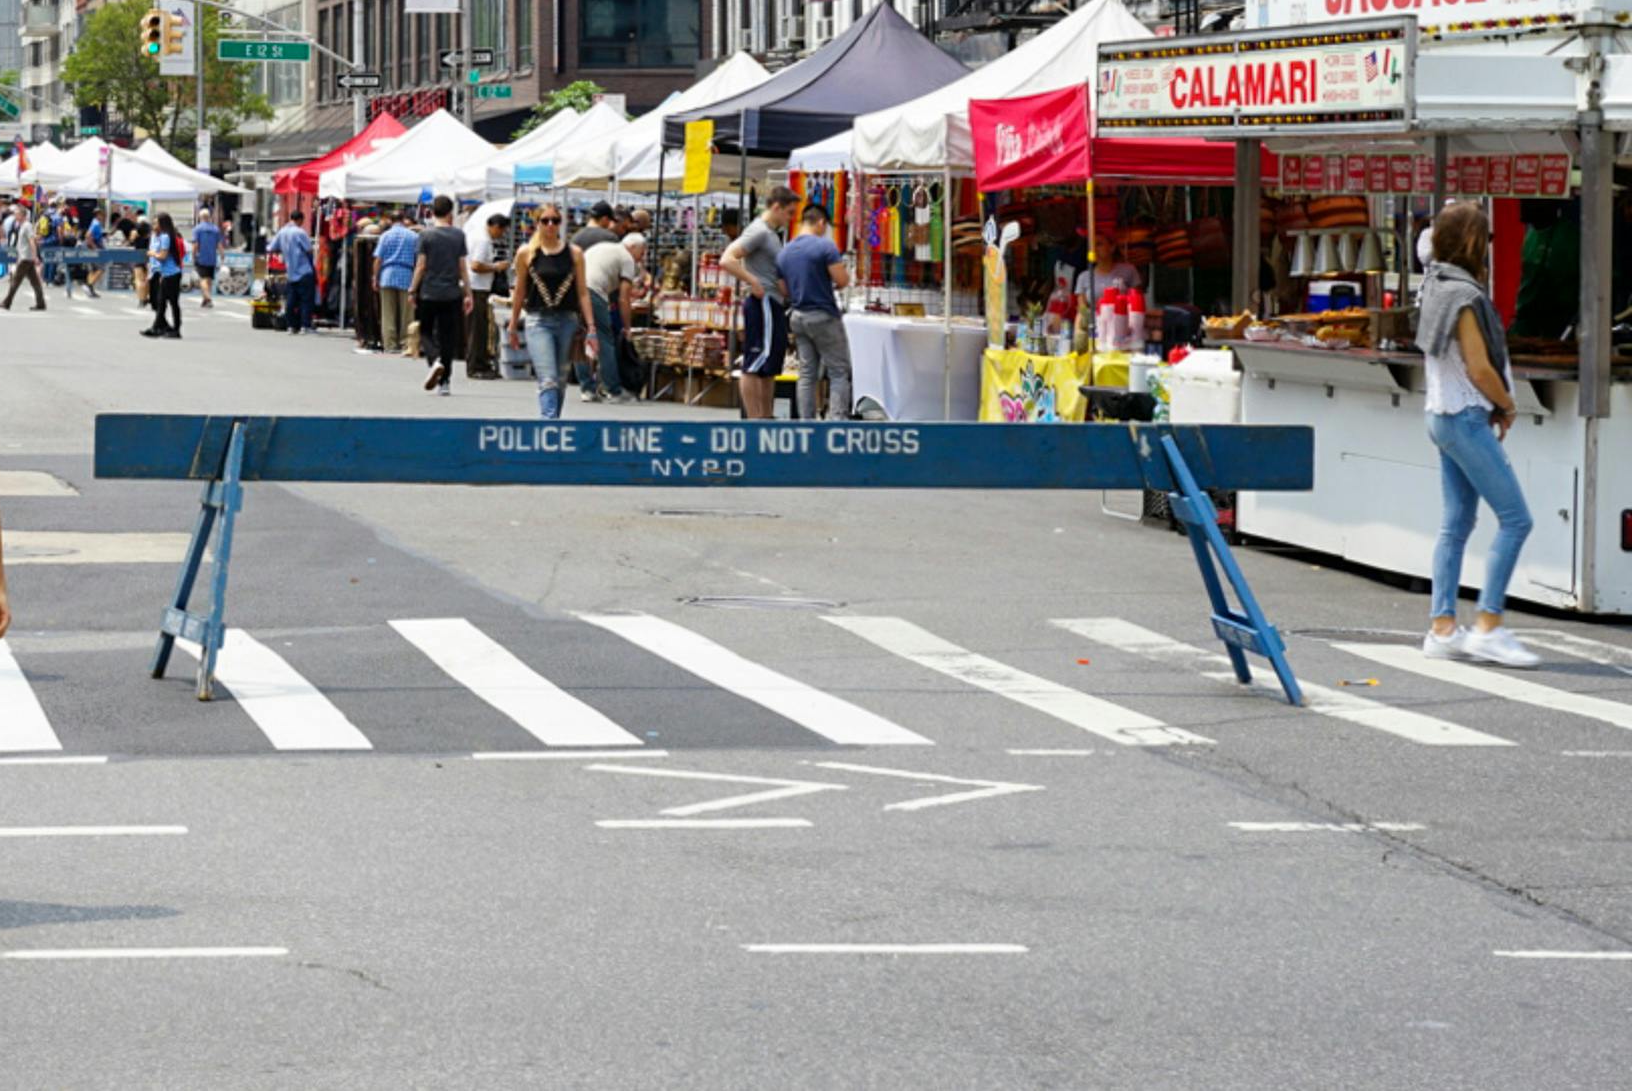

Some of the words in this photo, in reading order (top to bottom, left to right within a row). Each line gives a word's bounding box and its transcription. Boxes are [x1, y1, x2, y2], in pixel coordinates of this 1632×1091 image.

[245, 45, 253, 56] E
[257, 45, 267, 57] 12
[272, 46, 283, 57] St
[1169, 59, 1317, 109] CALAMARI
[479, 426, 576, 452] POLICE
[710, 427, 746, 454] DO
[759, 428, 813, 454] NOT
[827, 428, 920, 454] CROSS
[651, 458, 746, 477] NYPD
